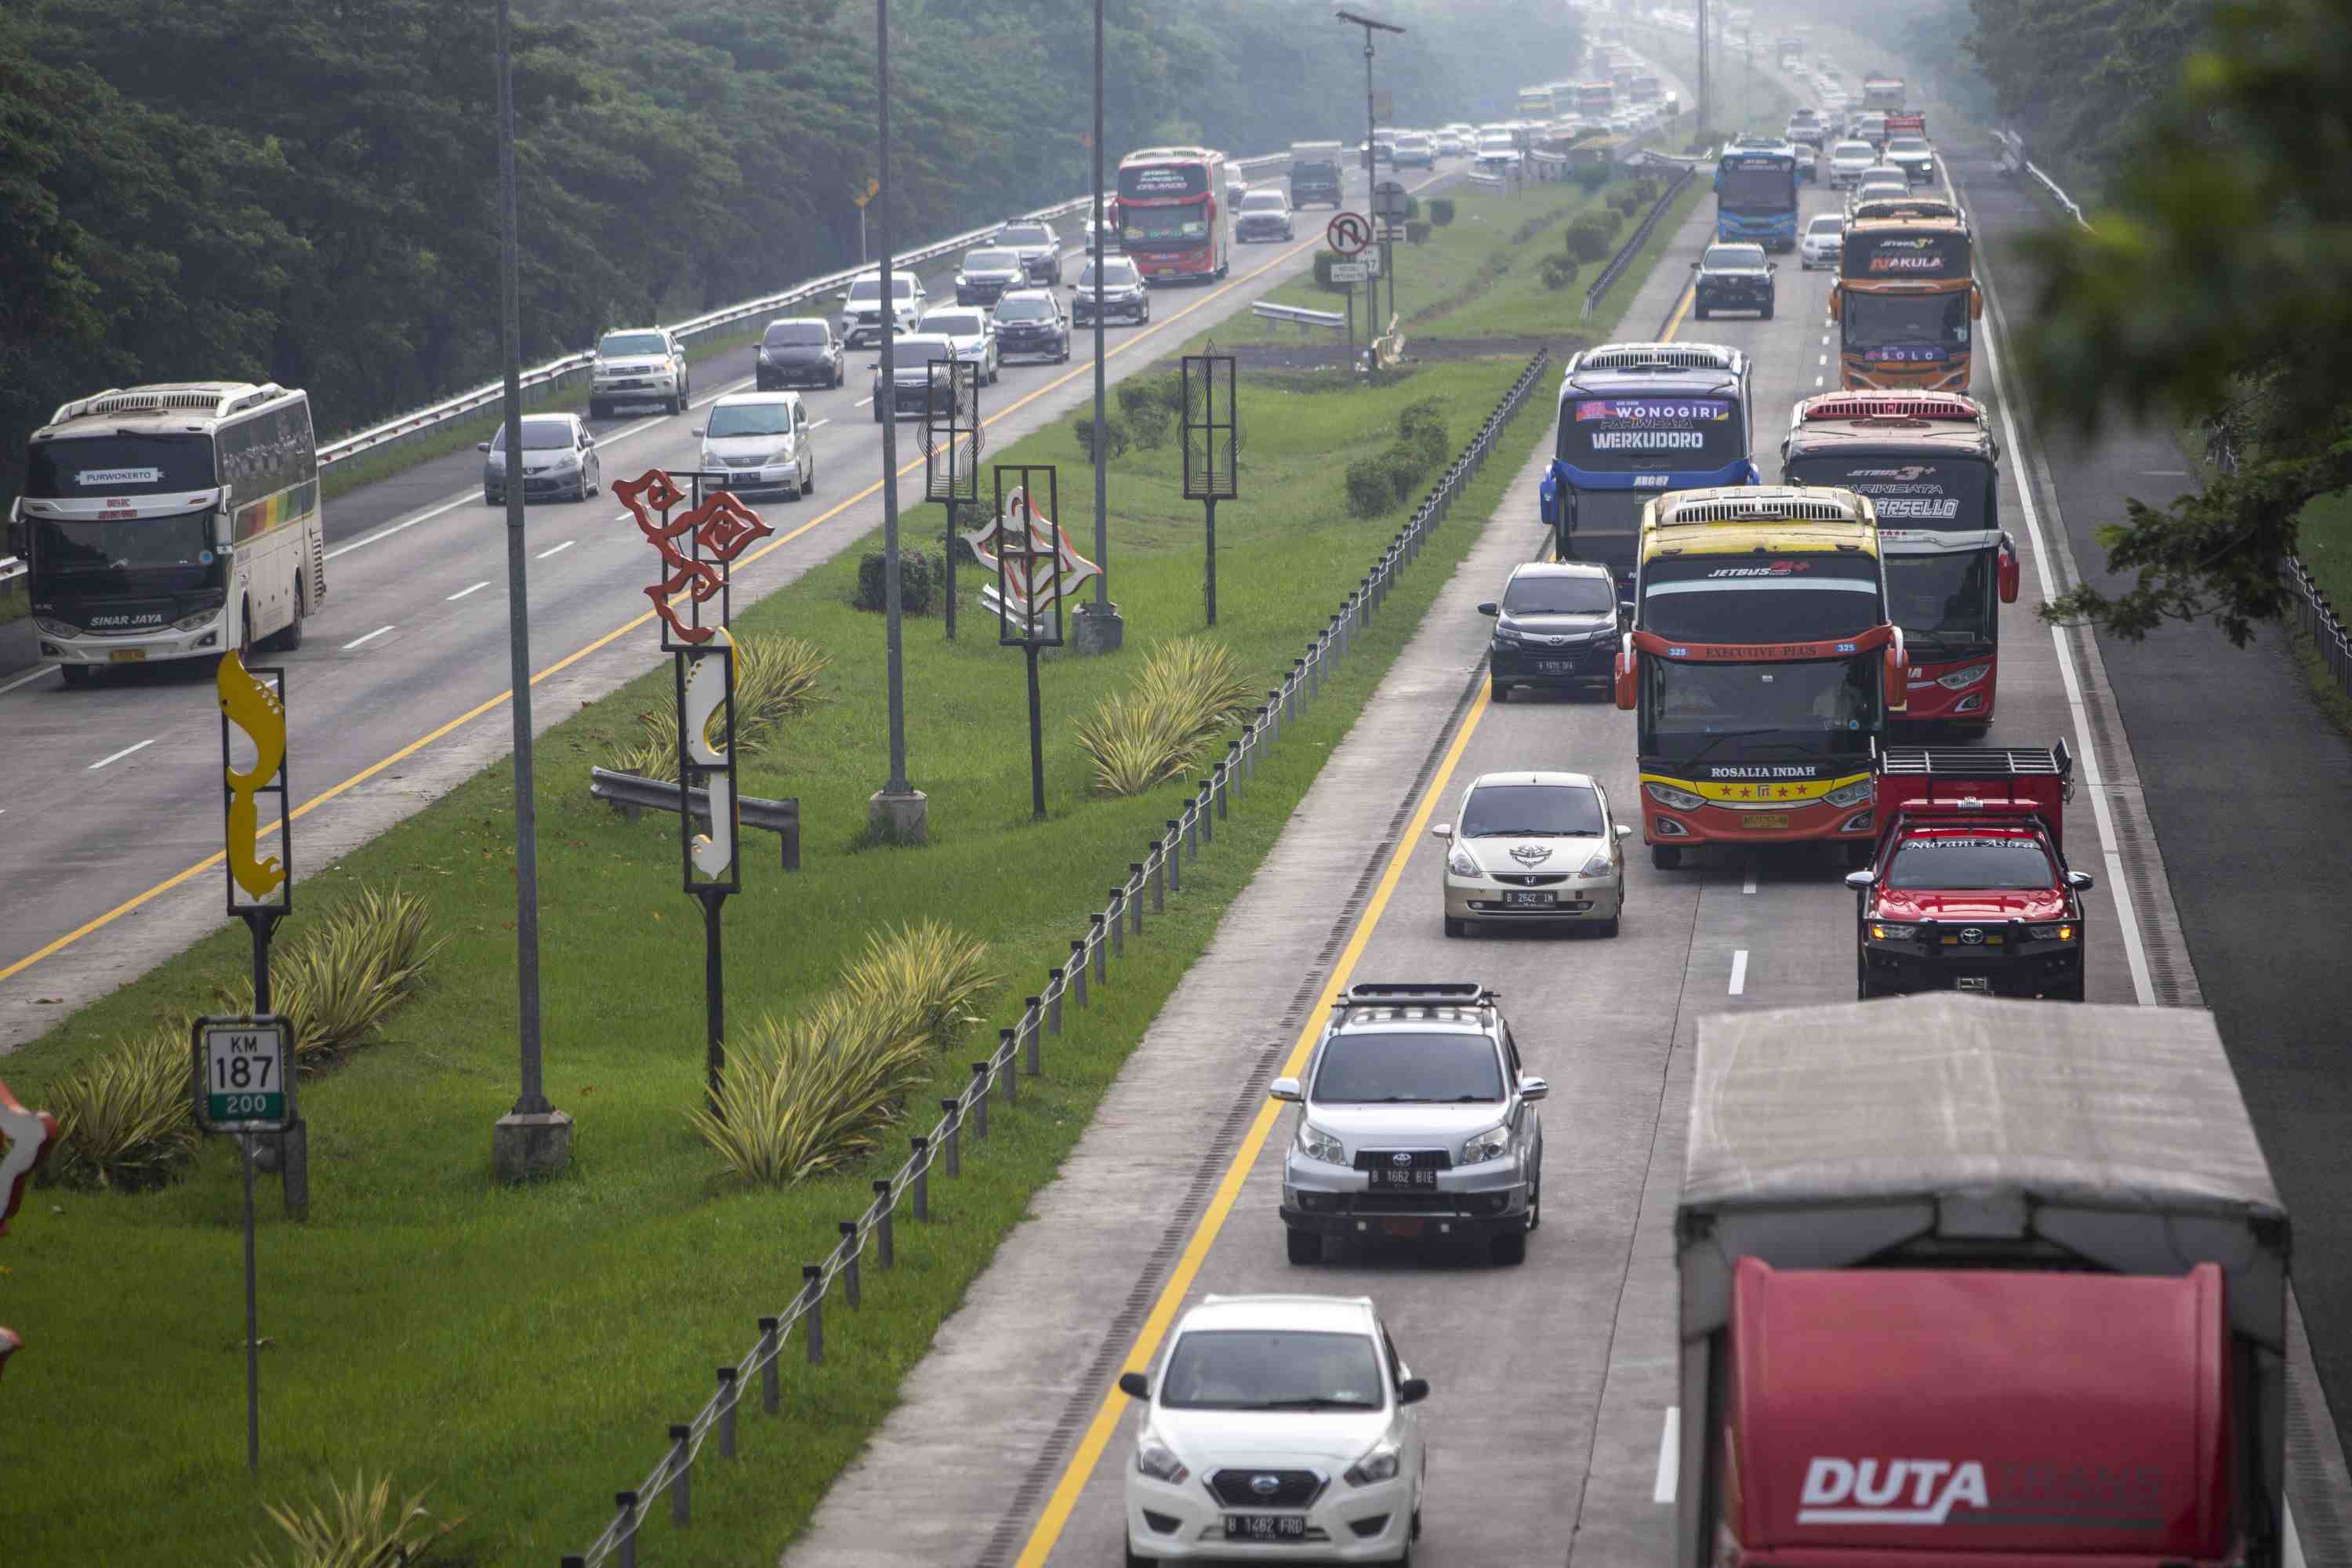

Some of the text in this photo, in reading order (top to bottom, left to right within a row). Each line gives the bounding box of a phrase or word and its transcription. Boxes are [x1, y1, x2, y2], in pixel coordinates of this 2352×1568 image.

[1870, 256, 1942, 268] NAKULA
[1882, 351, 1933, 361] SOLO
[1616, 407, 1718, 418] WONOGIRI
[1600, 419, 1694, 430] PARIWISATA
[1592, 432, 1704, 448] WERKUDORO
[86, 471, 151, 481] PURWOKERTO
[1871, 498, 1960, 519] ARSELLO
[90, 614, 163, 626] SINAR JAYA
[1669, 644, 1855, 659] 325 EXECUTIVE PLUS 325
[1711, 767, 1816, 778] ROSALIA INDAH
[1907, 839, 1977, 850] Nurani
[1507, 893, 1512, 902] B
[1518, 893, 1537, 903] 2642
[230, 1036, 257, 1053] KM
[216, 1055, 273, 1089] 187
[227, 1095, 267, 1113] 200
[1373, 1171, 1379, 1182] B
[1801, 1456, 2162, 1508] DUTA TRANS
[1229, 1517, 1236, 1531] B
